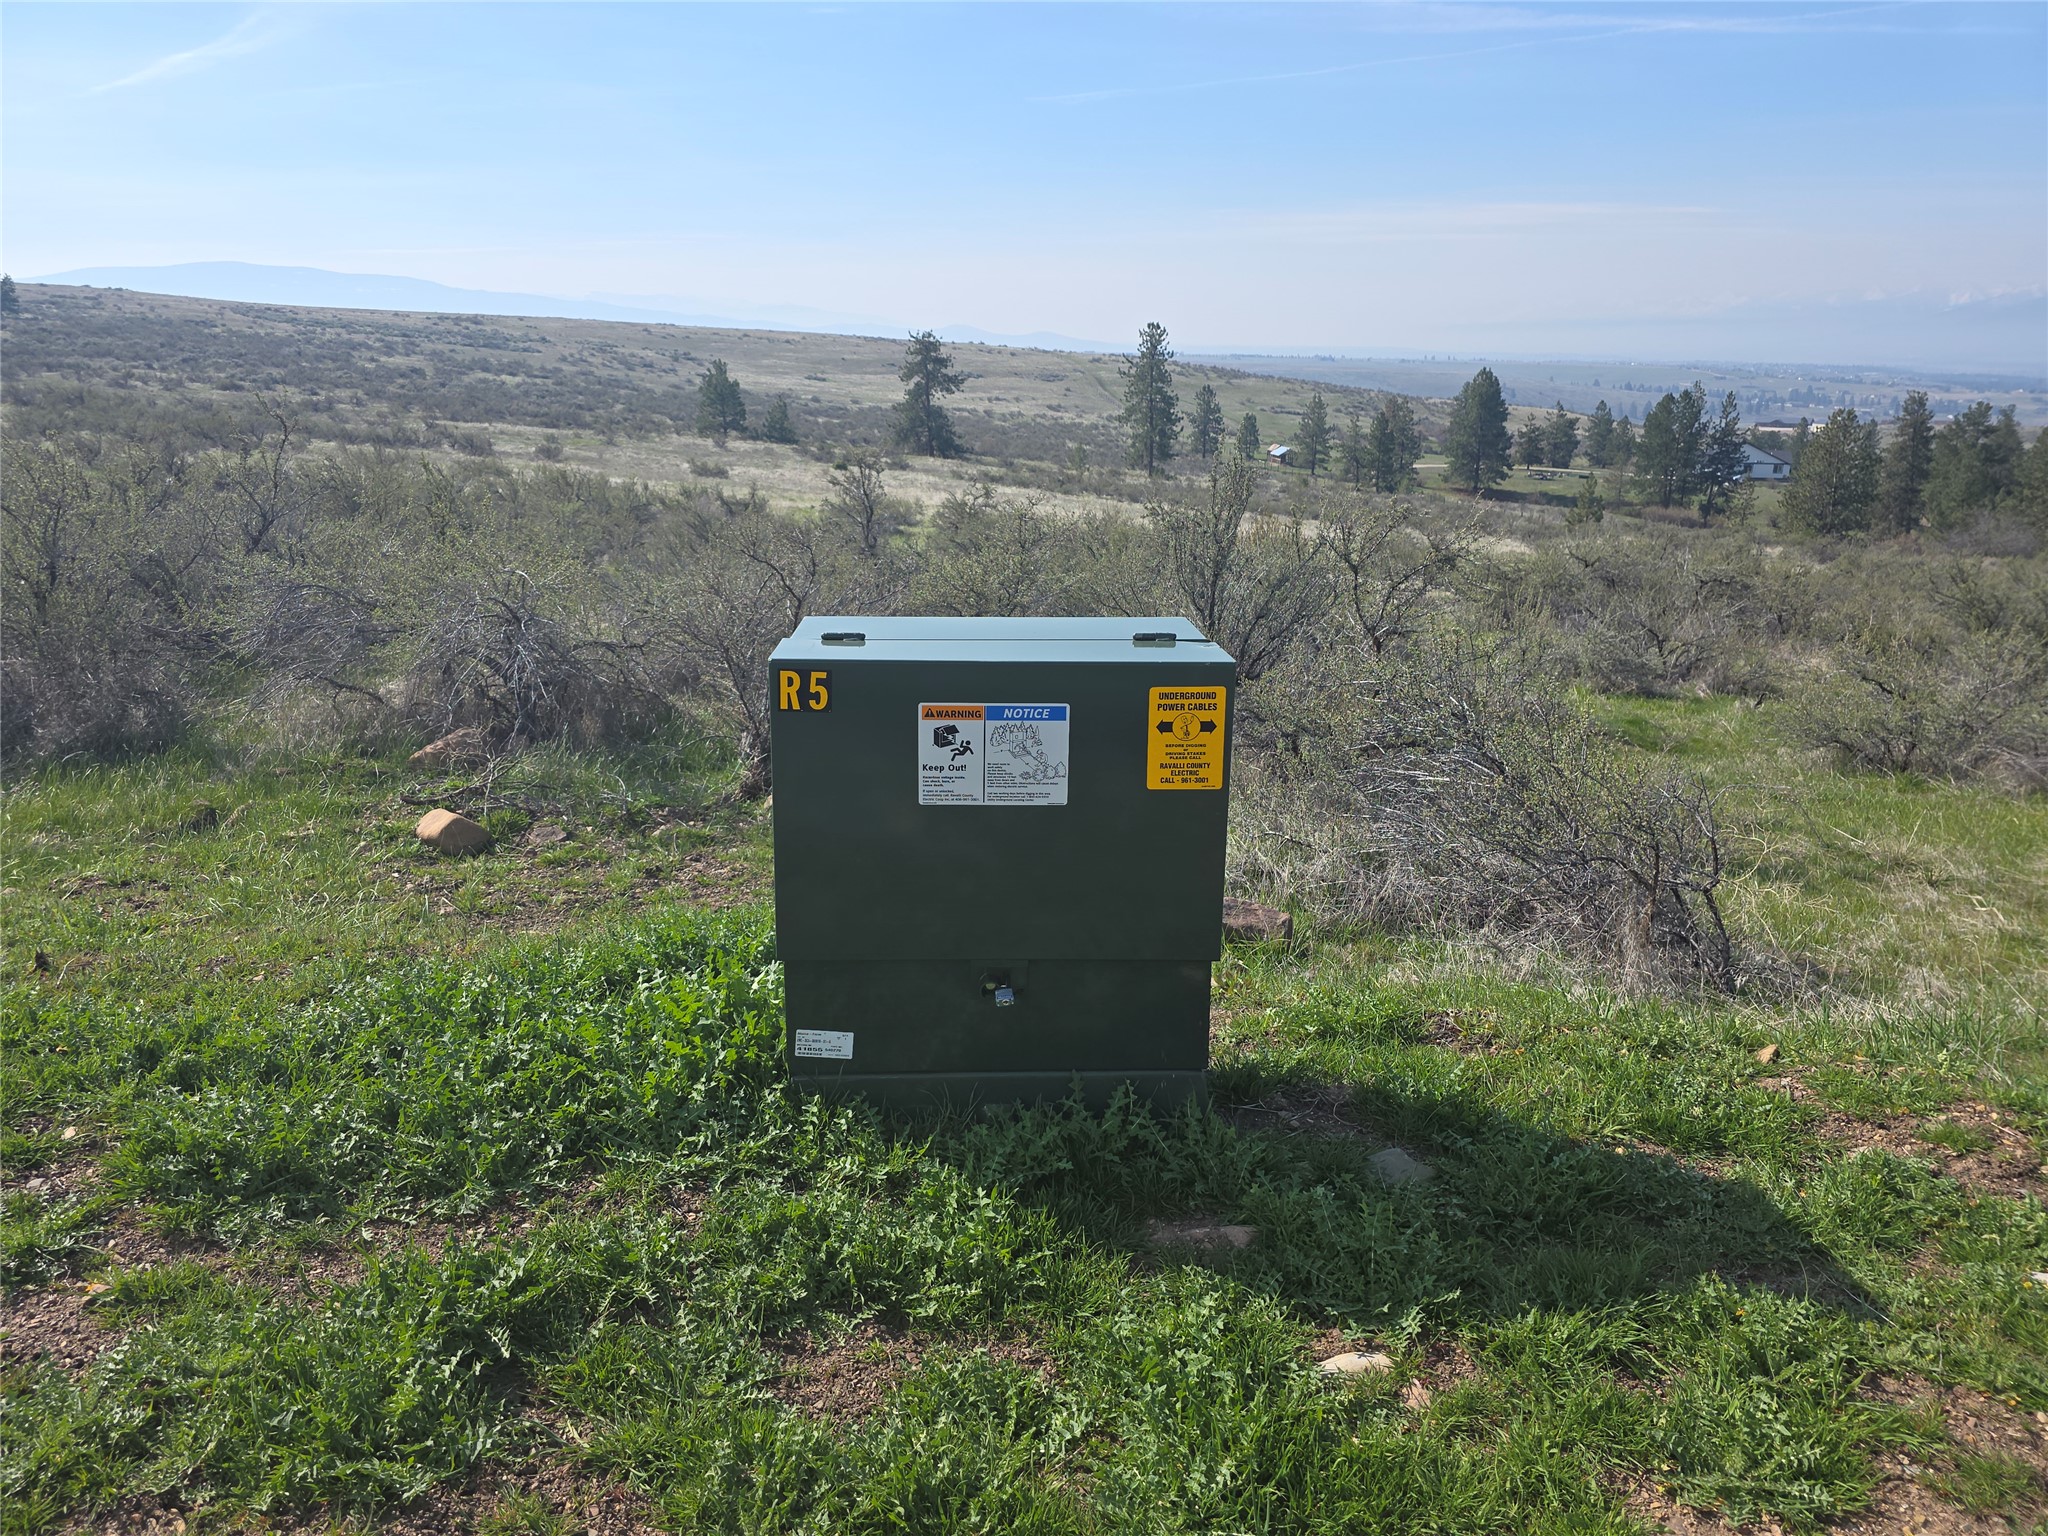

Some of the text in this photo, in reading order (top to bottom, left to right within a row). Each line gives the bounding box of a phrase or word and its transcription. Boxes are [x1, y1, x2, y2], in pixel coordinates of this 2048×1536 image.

[780, 670, 828, 710] R 5
[1158, 692, 1217, 700] UNDERGROUND
[1003, 708, 1050, 718] NOTICE
[922, 764, 944, 773] Keep
